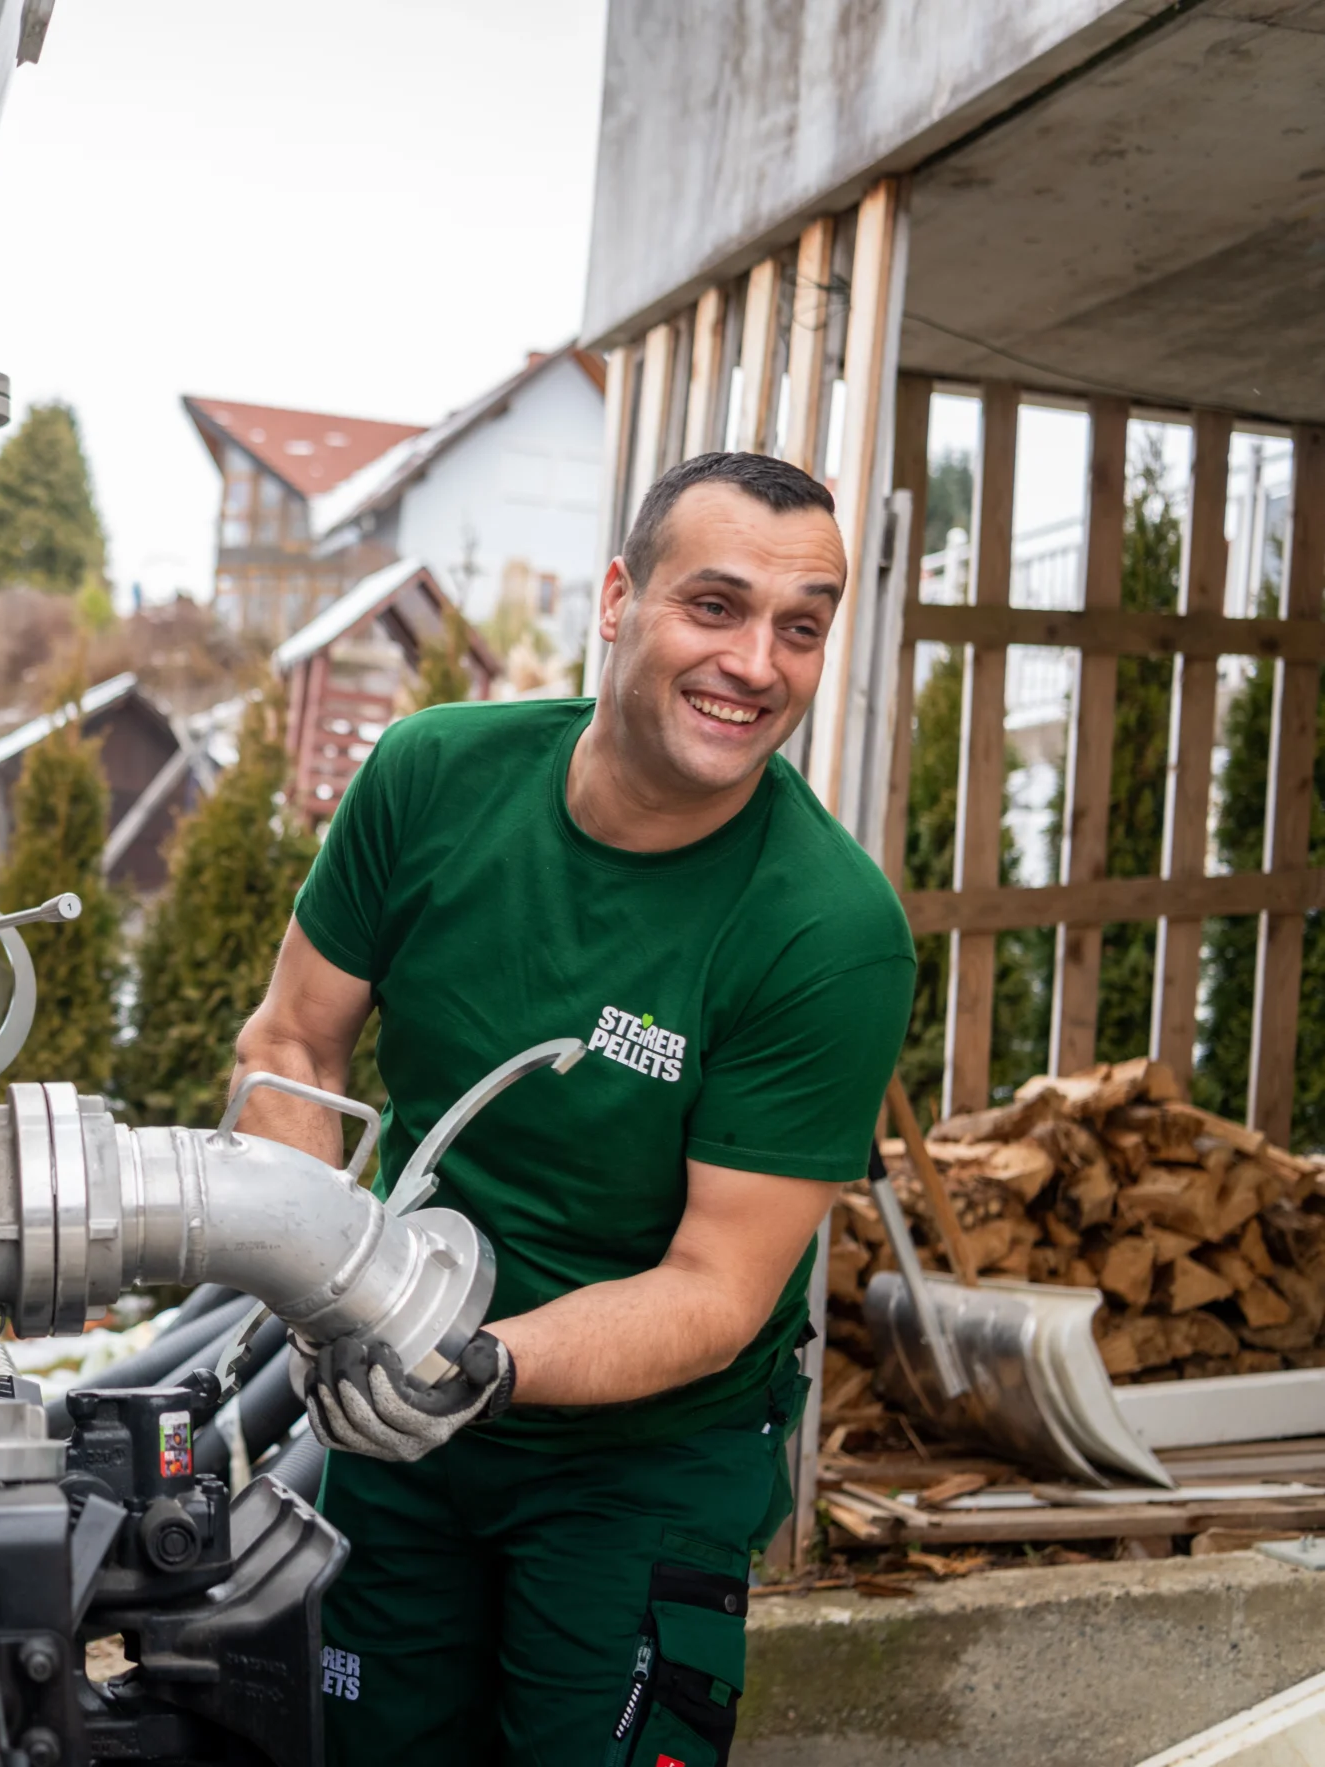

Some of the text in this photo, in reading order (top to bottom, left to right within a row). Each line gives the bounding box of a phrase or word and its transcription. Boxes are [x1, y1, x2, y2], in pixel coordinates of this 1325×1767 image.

[598, 1006, 686, 1059] STEIRER
[587, 1027, 682, 1082] PELLETS
[320, 1645, 360, 1677] RER
[321, 1669, 360, 1700] ETS
